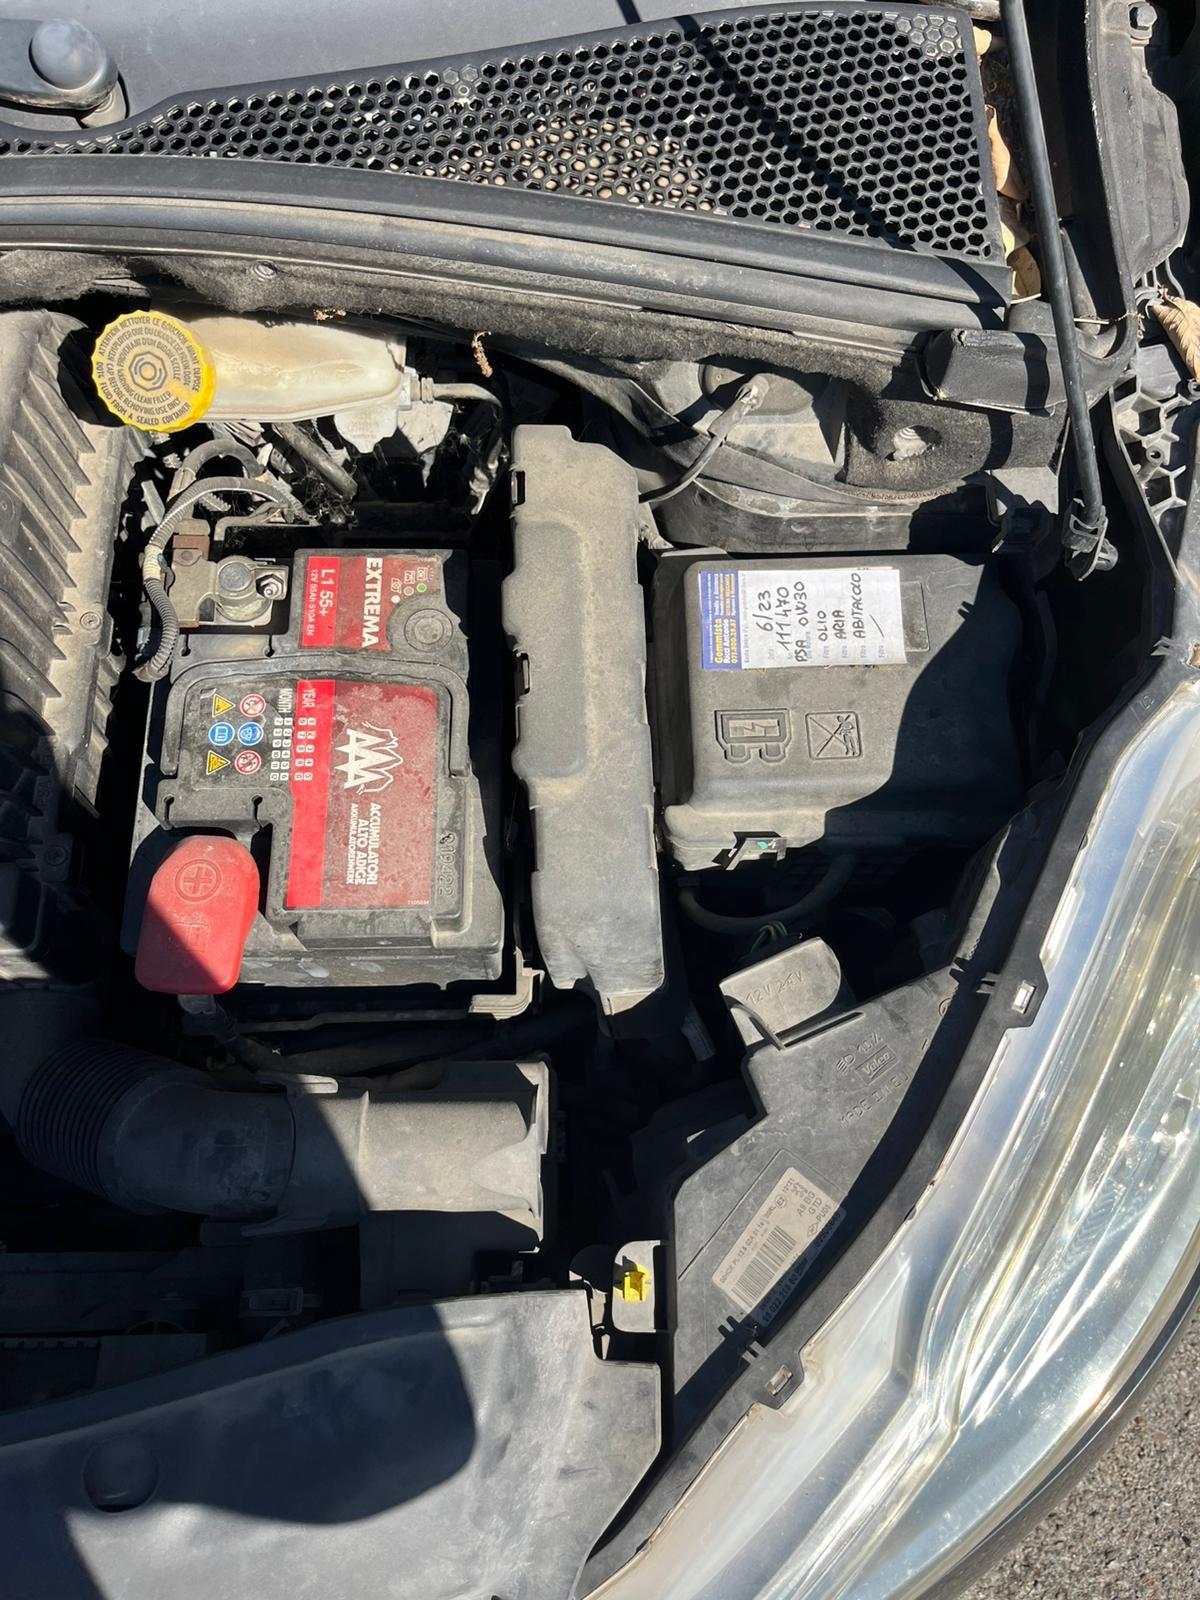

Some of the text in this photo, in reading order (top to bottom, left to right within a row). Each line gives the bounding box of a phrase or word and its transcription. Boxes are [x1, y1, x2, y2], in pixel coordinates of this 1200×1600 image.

[309, 569, 318, 582] 12V
[319, 569, 336, 616] L1 55+
[362, 558, 383, 648] EXTREMA
[752, 589, 773, 631] 6/23
[832, 609, 847, 639] ARIA
[306, 624, 315, 636] EN
[714, 618, 723, 663] Gommista
[817, 610, 828, 641] OLIO
[794, 639, 808, 662] PSA
[278, 688, 292, 713] MONTH
[302, 688, 315, 708] YEAR
[354, 819, 370, 885] ALTO ADIGE
[368, 802, 381, 885] ACCUMULATORI
[862, 1051, 891, 1075] Valeo
